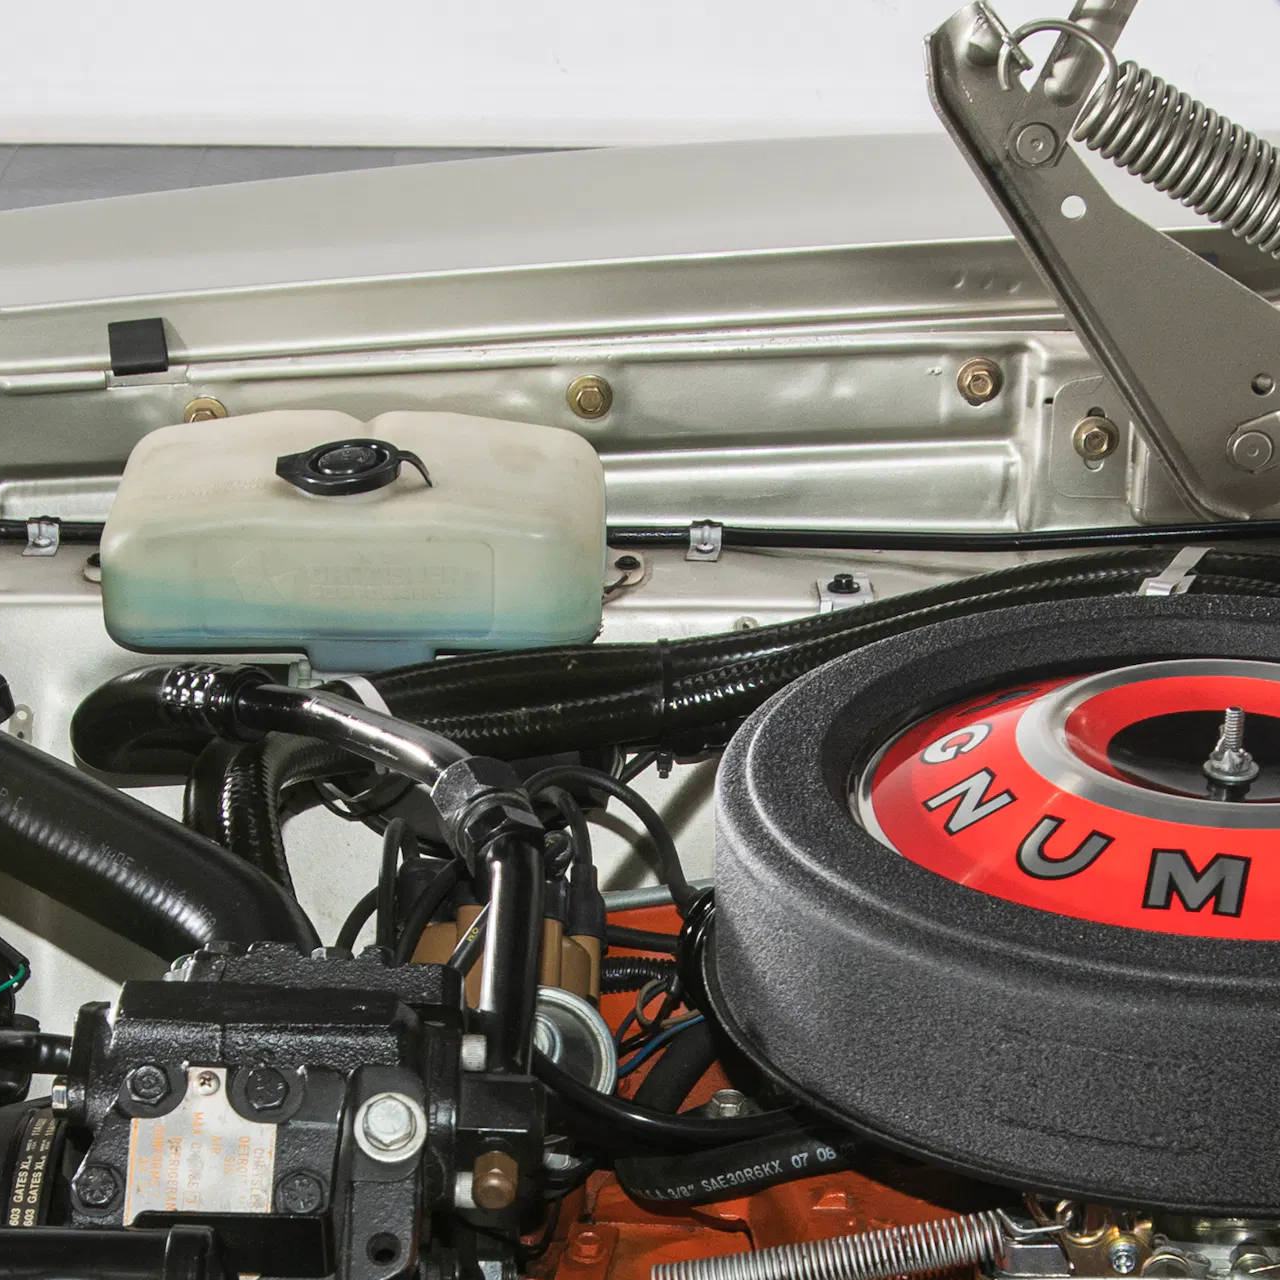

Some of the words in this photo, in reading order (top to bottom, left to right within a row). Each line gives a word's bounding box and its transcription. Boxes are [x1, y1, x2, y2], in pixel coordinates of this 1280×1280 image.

[13, 1171, 29, 1203] GATES
[27, 1171, 43, 1204] GATES
[701, 1159, 784, 1193] SAE30R6KX
[791, 1152, 810, 1169] 07
[9, 1208, 21, 1227] 603
[23, 1208, 35, 1227] 603
